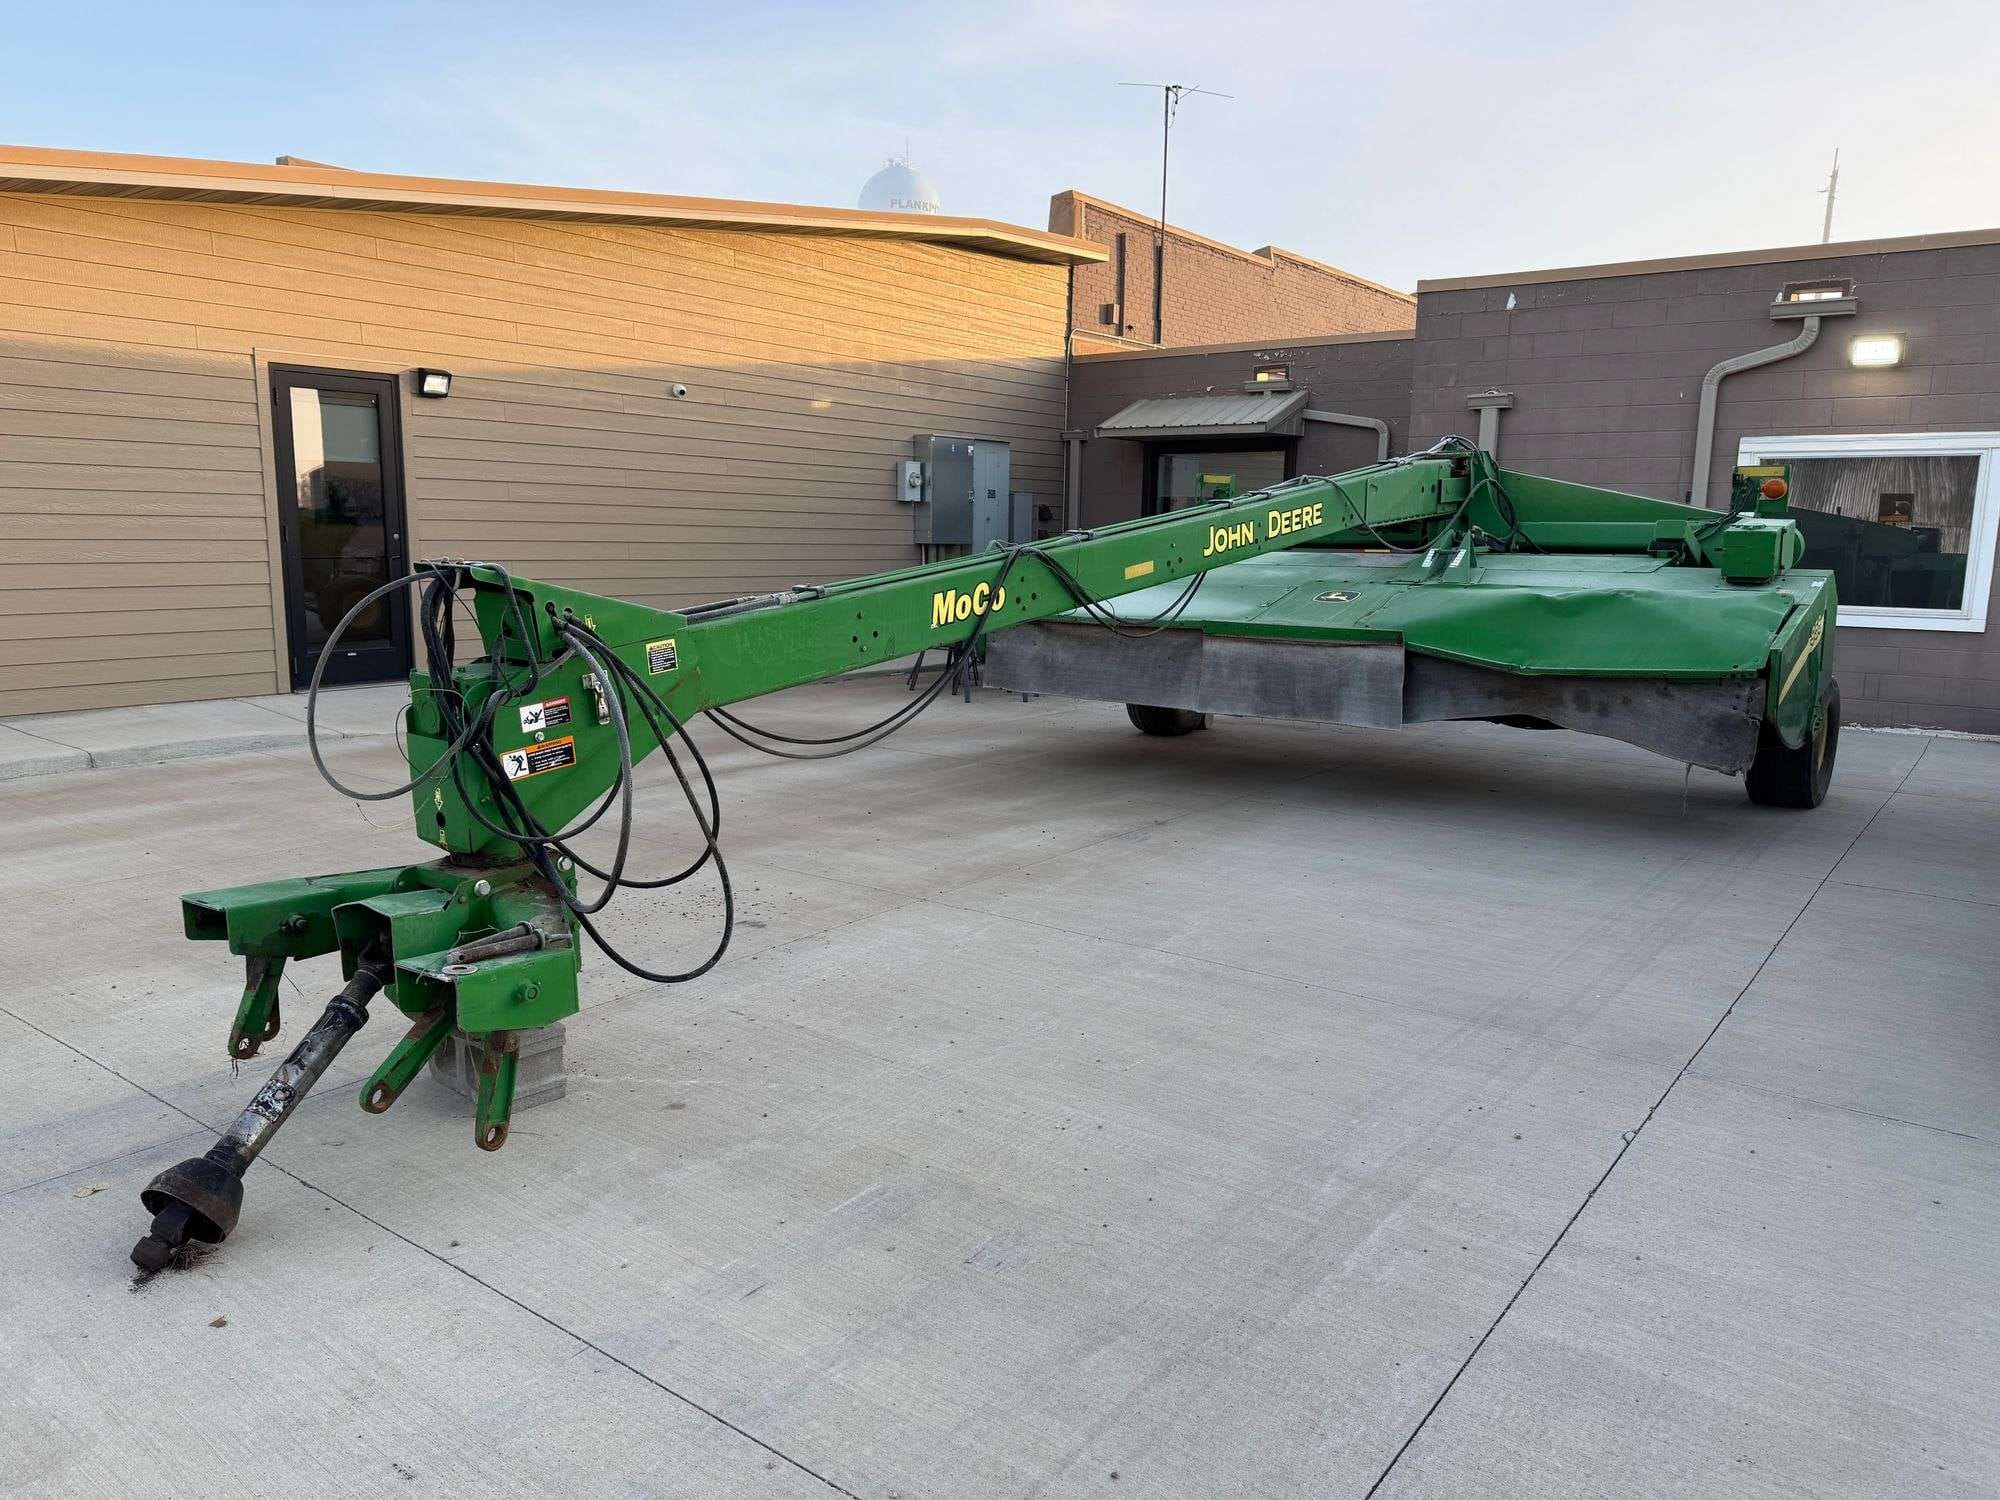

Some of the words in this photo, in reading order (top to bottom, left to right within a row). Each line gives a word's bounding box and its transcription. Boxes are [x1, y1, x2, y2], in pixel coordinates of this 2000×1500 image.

[1203, 520, 1254, 557] JOHN
[1267, 502, 1323, 539] DEERE
[931, 582, 1006, 629] MoCo
